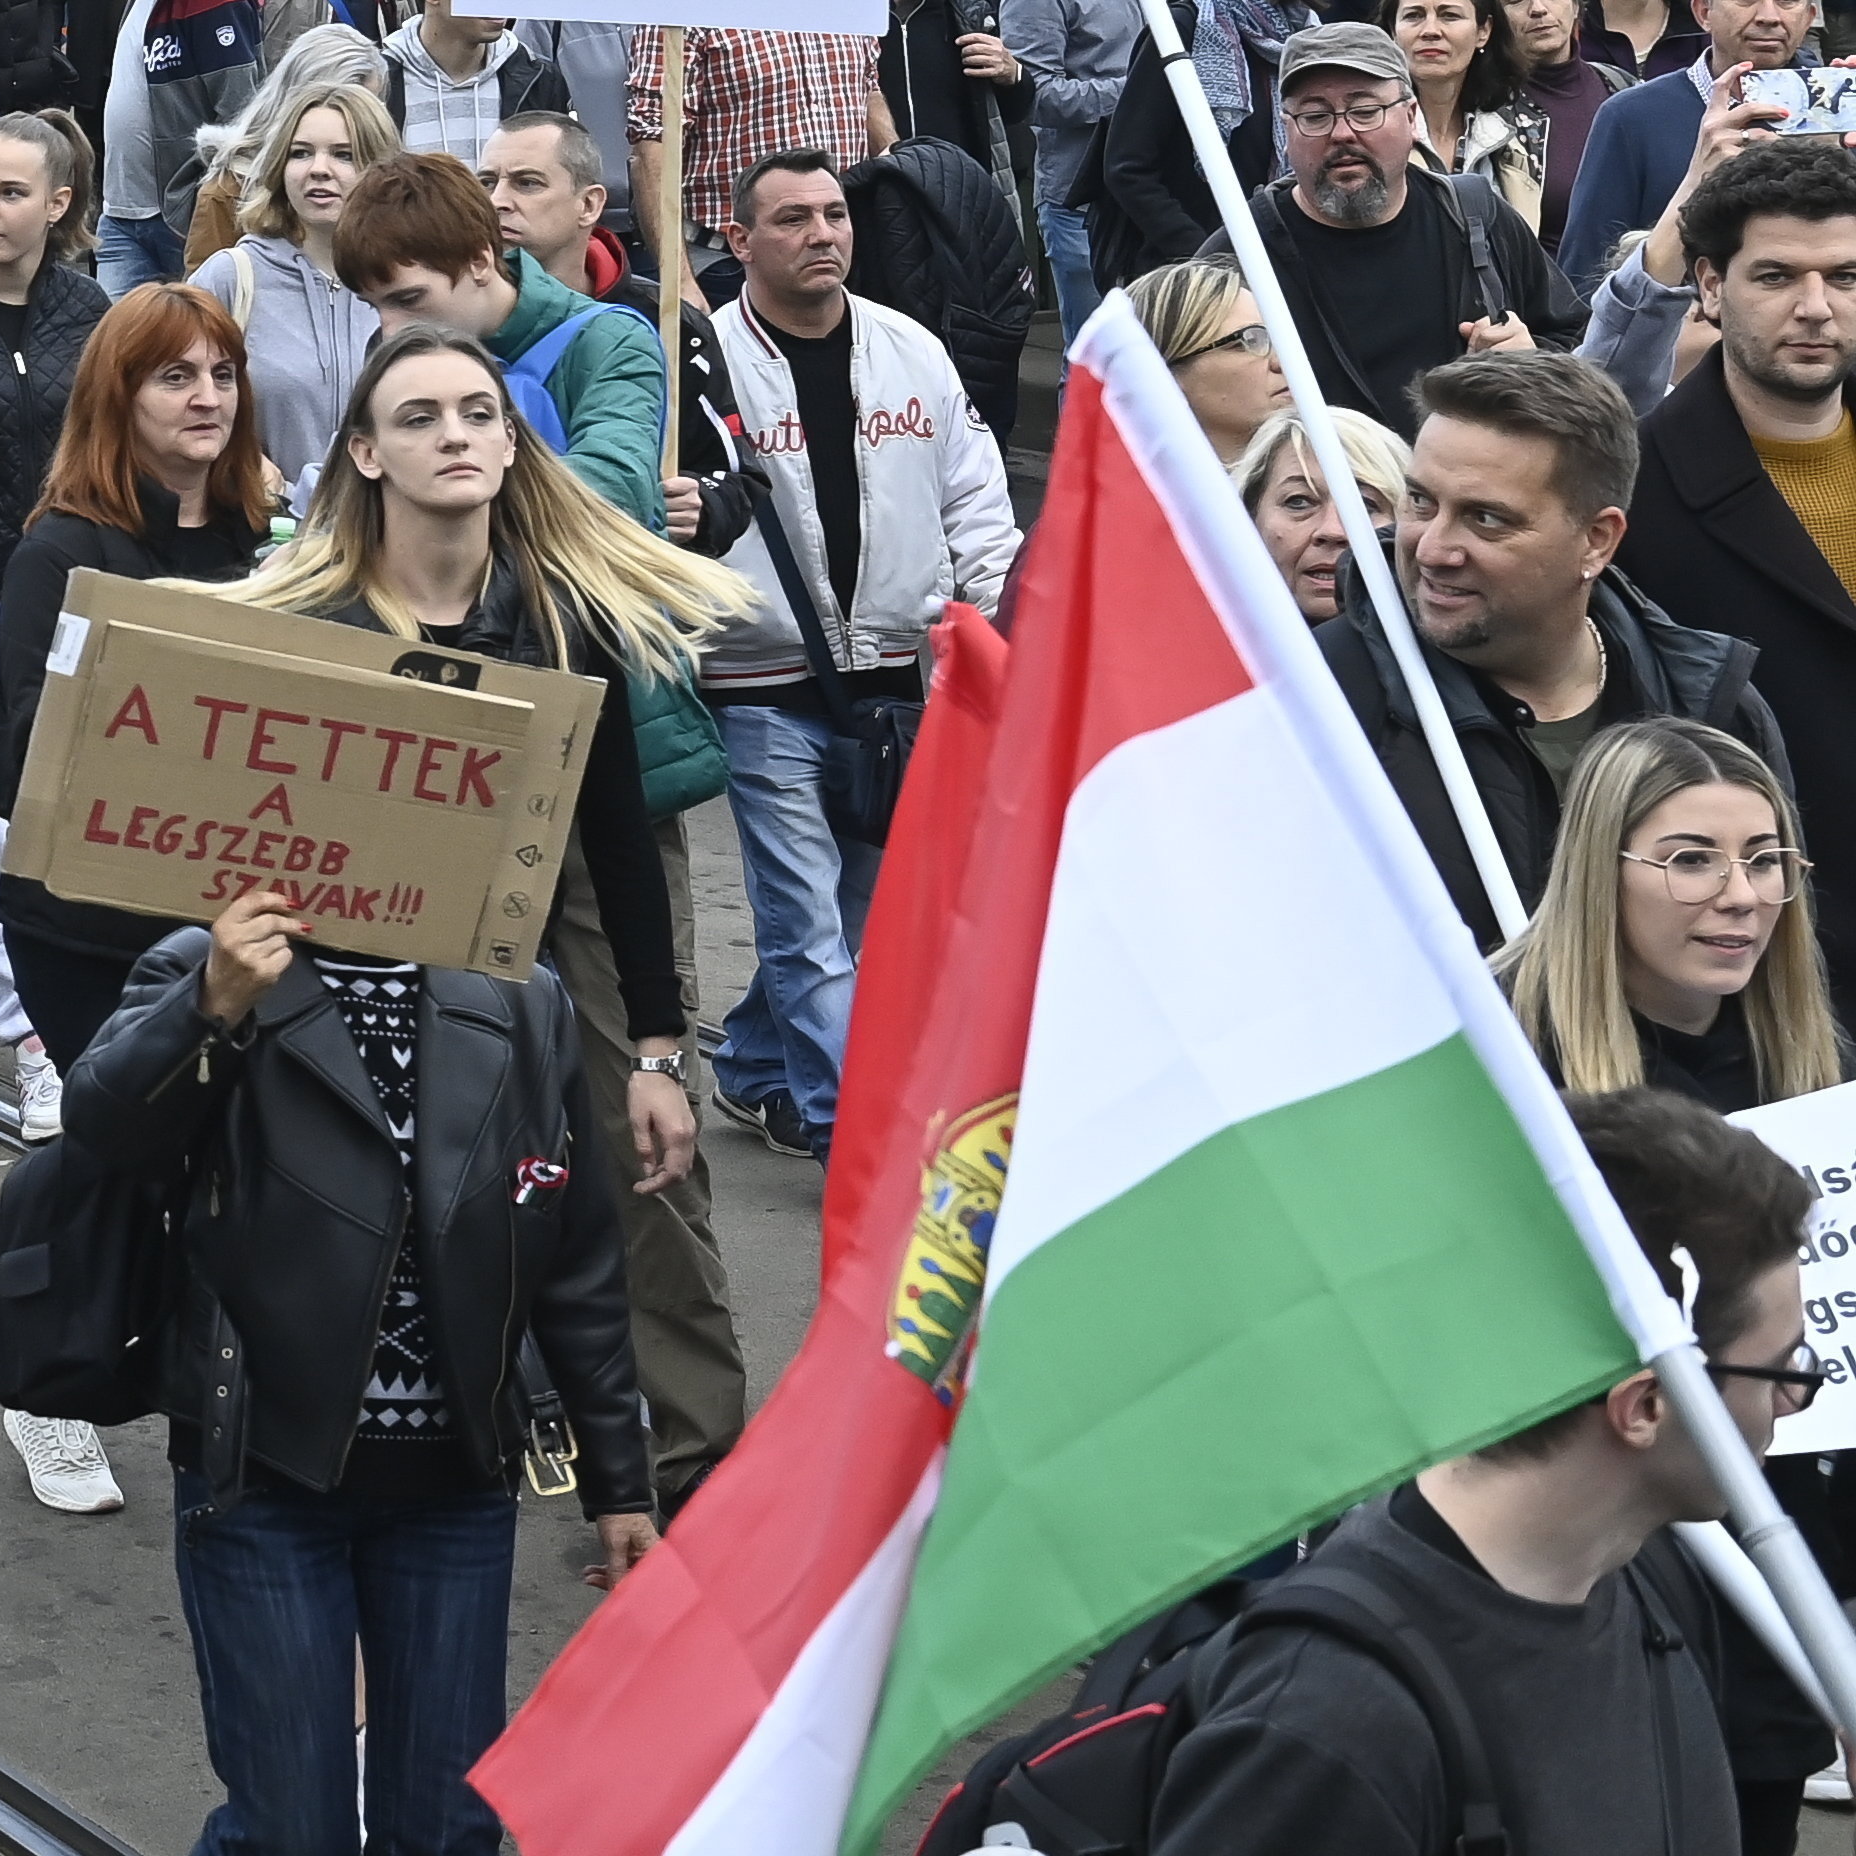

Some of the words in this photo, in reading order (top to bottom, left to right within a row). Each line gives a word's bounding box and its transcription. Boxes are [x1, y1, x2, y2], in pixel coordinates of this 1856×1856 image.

[104, 682, 160, 747] A
[193, 694, 502, 809] TETTEK
[83, 798, 351, 877] LEGSZEBB
[247, 783, 294, 828] A
